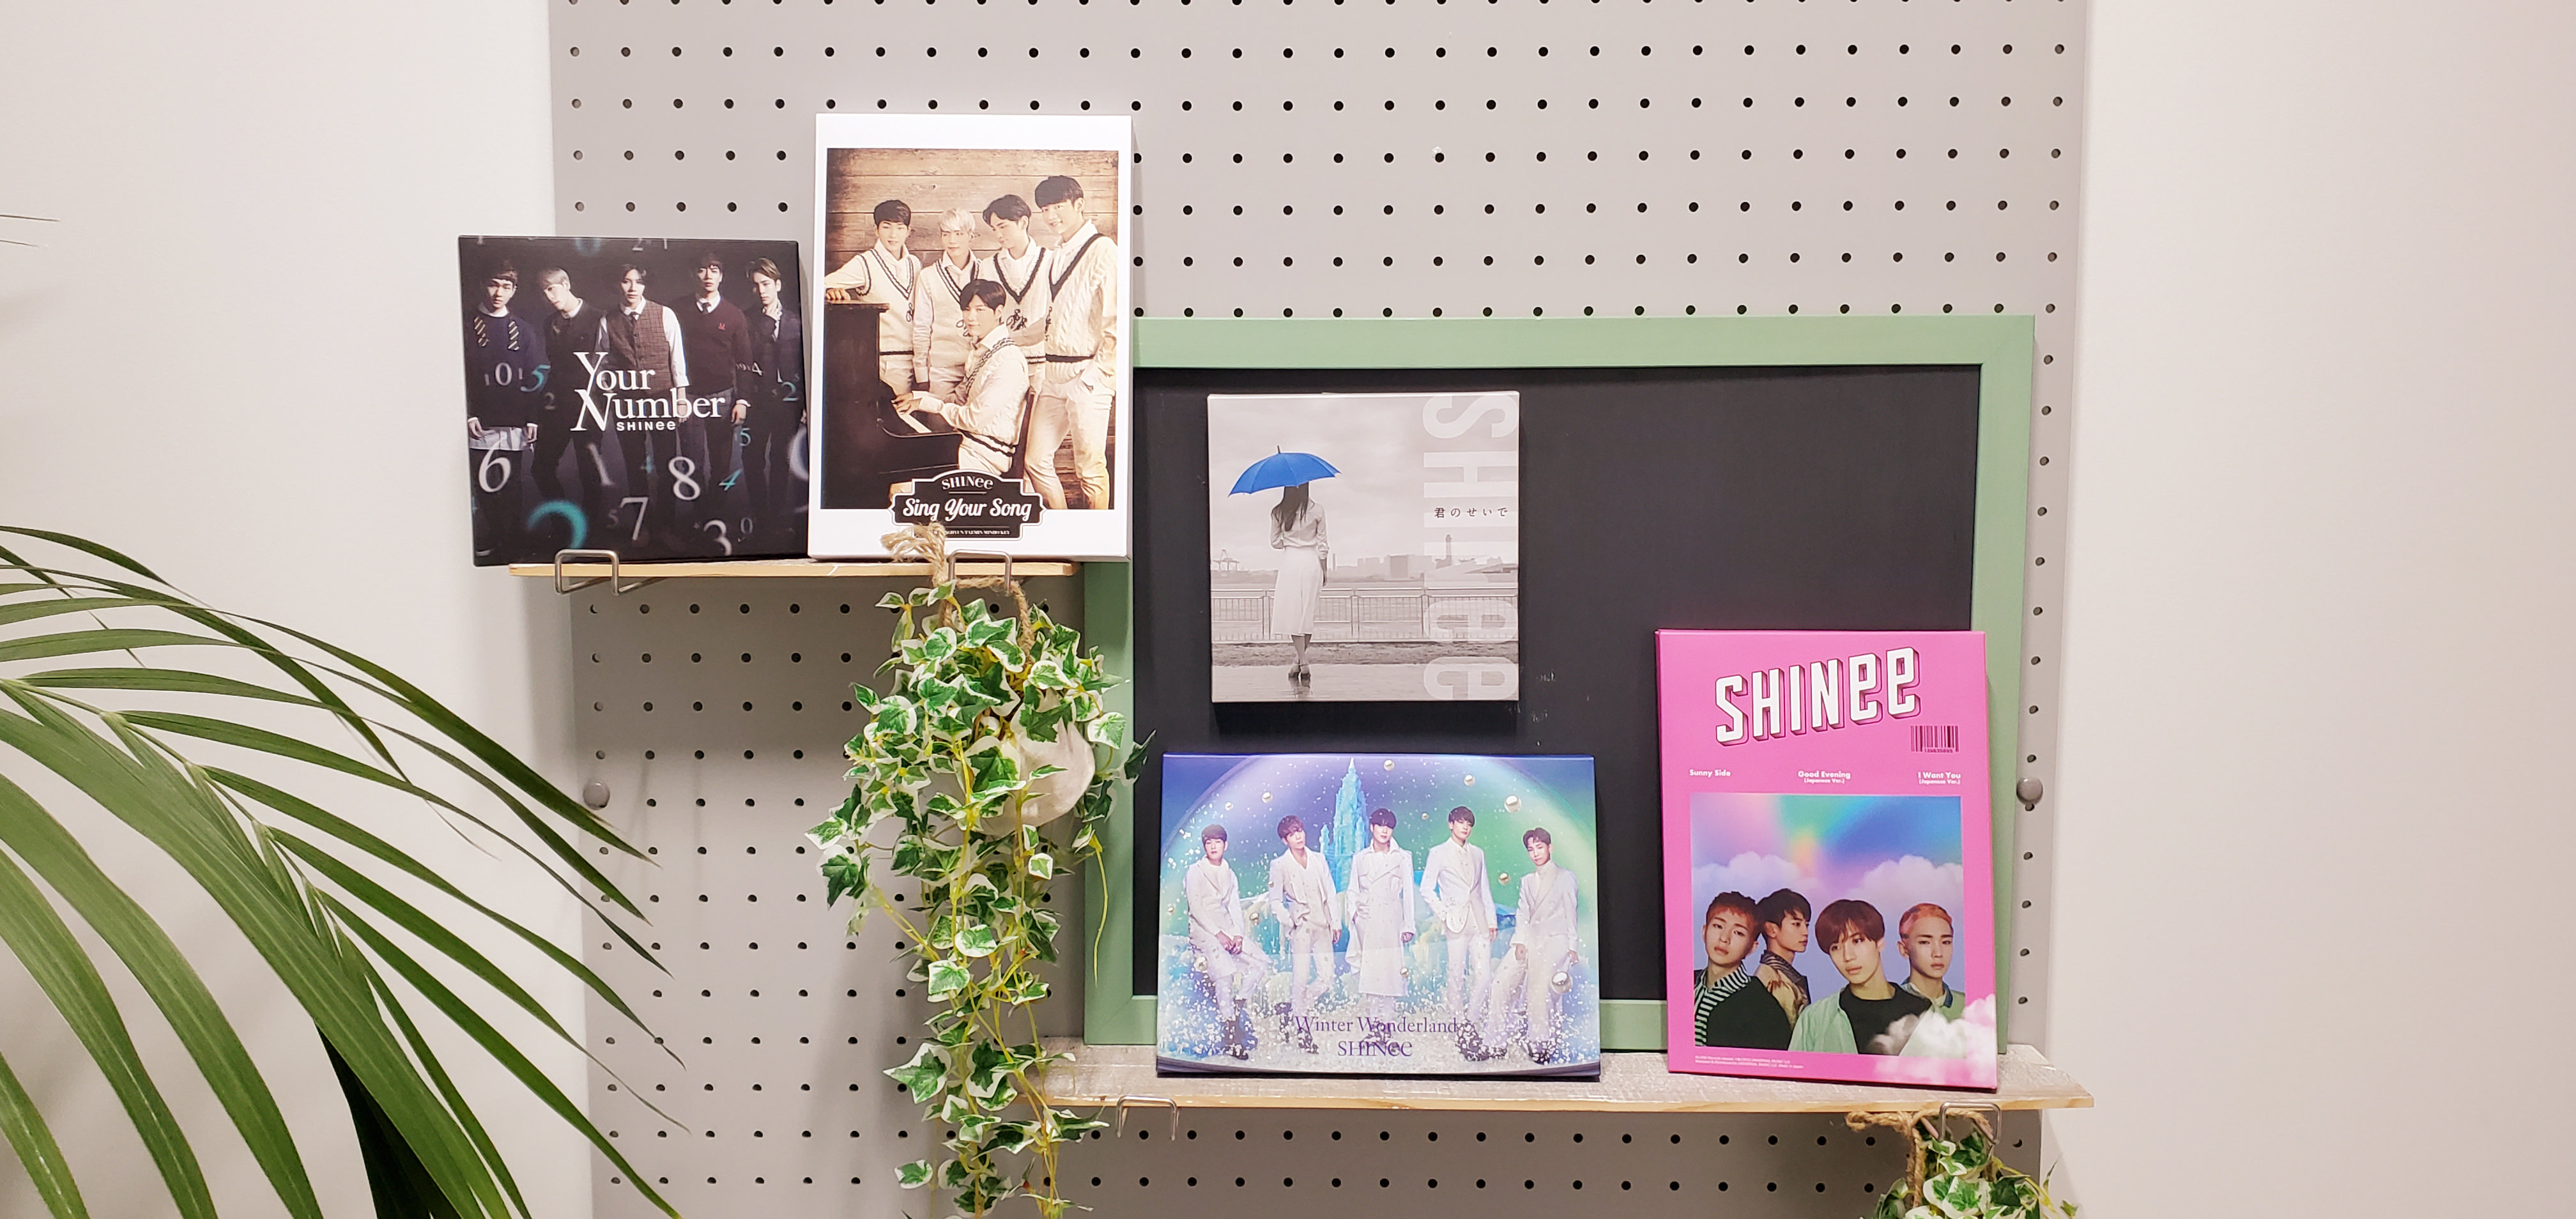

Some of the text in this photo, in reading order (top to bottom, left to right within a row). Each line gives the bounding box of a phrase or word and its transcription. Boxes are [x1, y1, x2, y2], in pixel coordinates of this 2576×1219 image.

[573, 352, 656, 395] Your
[570, 388, 726, 431] Number
[617, 421, 677, 431] SHINee
[479, 440, 510, 493] 6
[668, 456, 701, 500] 8
[942, 475, 993, 490] SHINee
[619, 496, 649, 541] 7
[903, 498, 1032, 522] Sing Your Song
[1434, 507, 1508, 518] 君のせいで
[1715, 647, 1920, 746] SHINee
[1689, 769, 1712, 778] Sunny
[1821, 771, 1851, 779] Evening
[1295, 1016, 1457, 1033] Winter Wonderland
